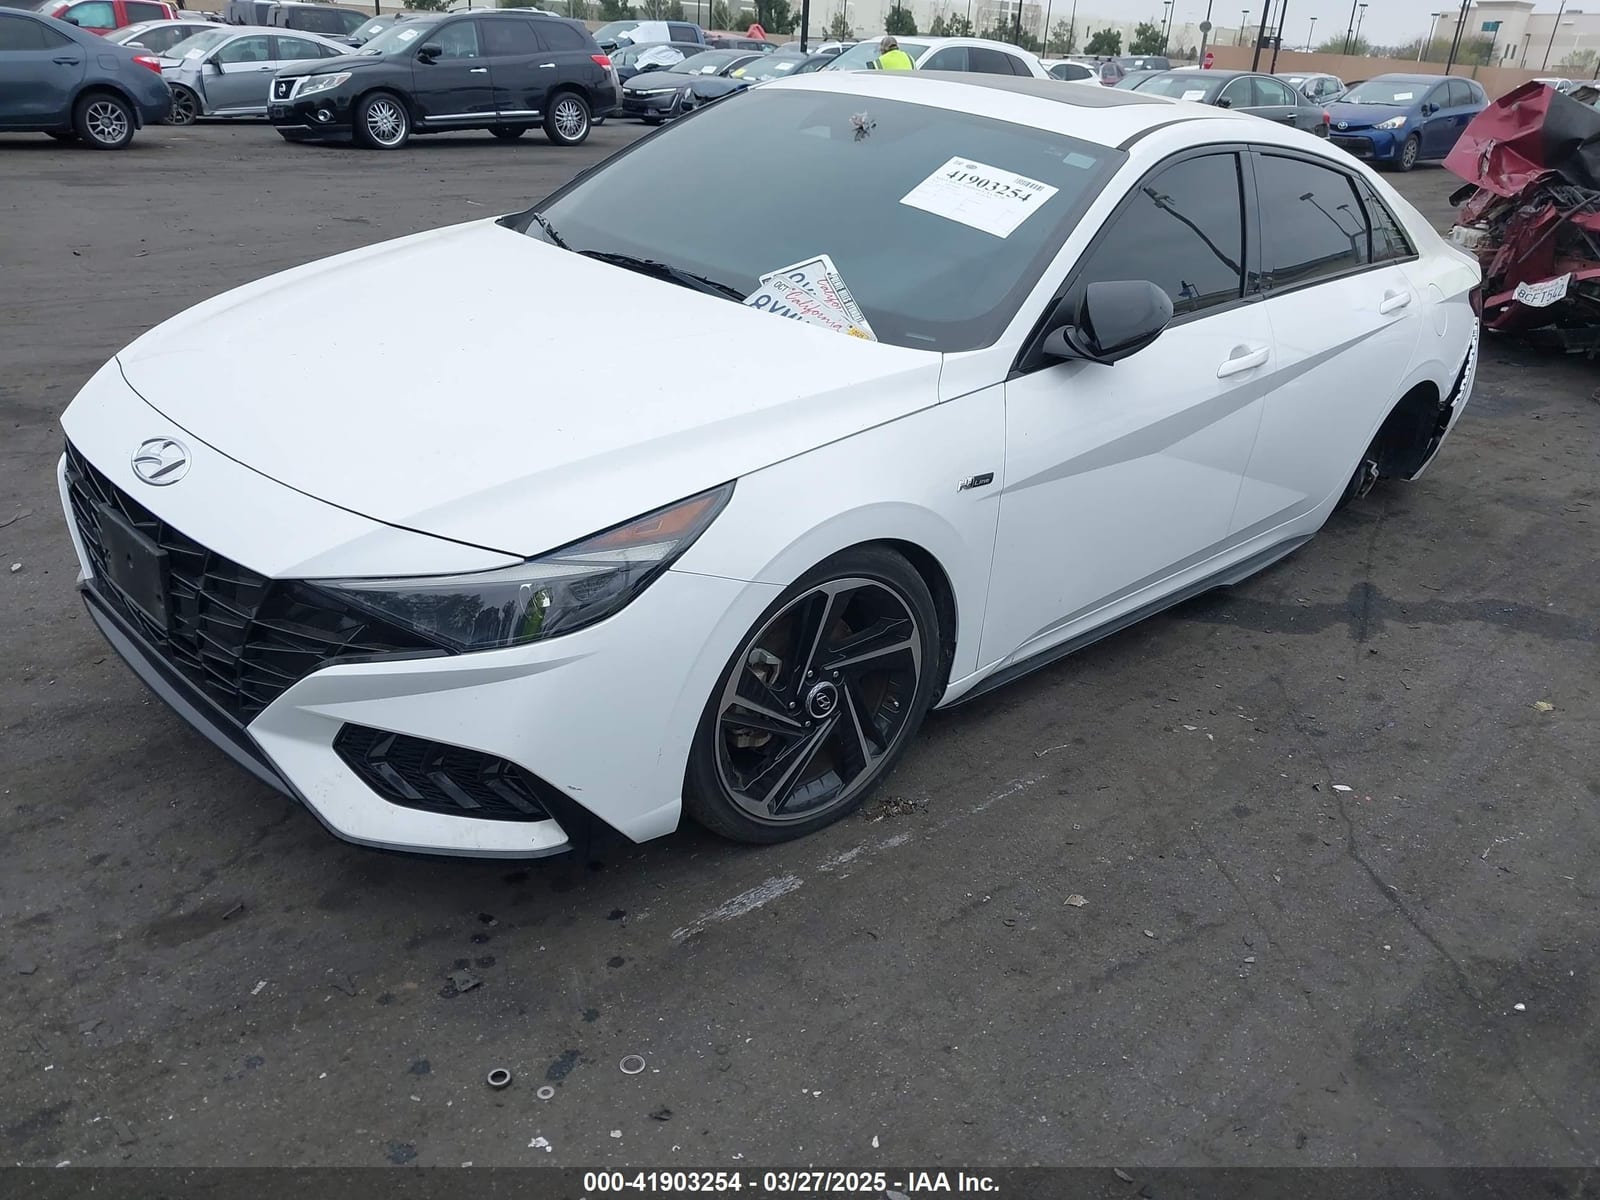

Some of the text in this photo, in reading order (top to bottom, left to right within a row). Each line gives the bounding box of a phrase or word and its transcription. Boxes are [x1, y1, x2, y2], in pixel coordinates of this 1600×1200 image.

[946, 169, 1033, 203] 41903254
[773, 280, 790, 292] OCT
[785, 290, 843, 333] California
